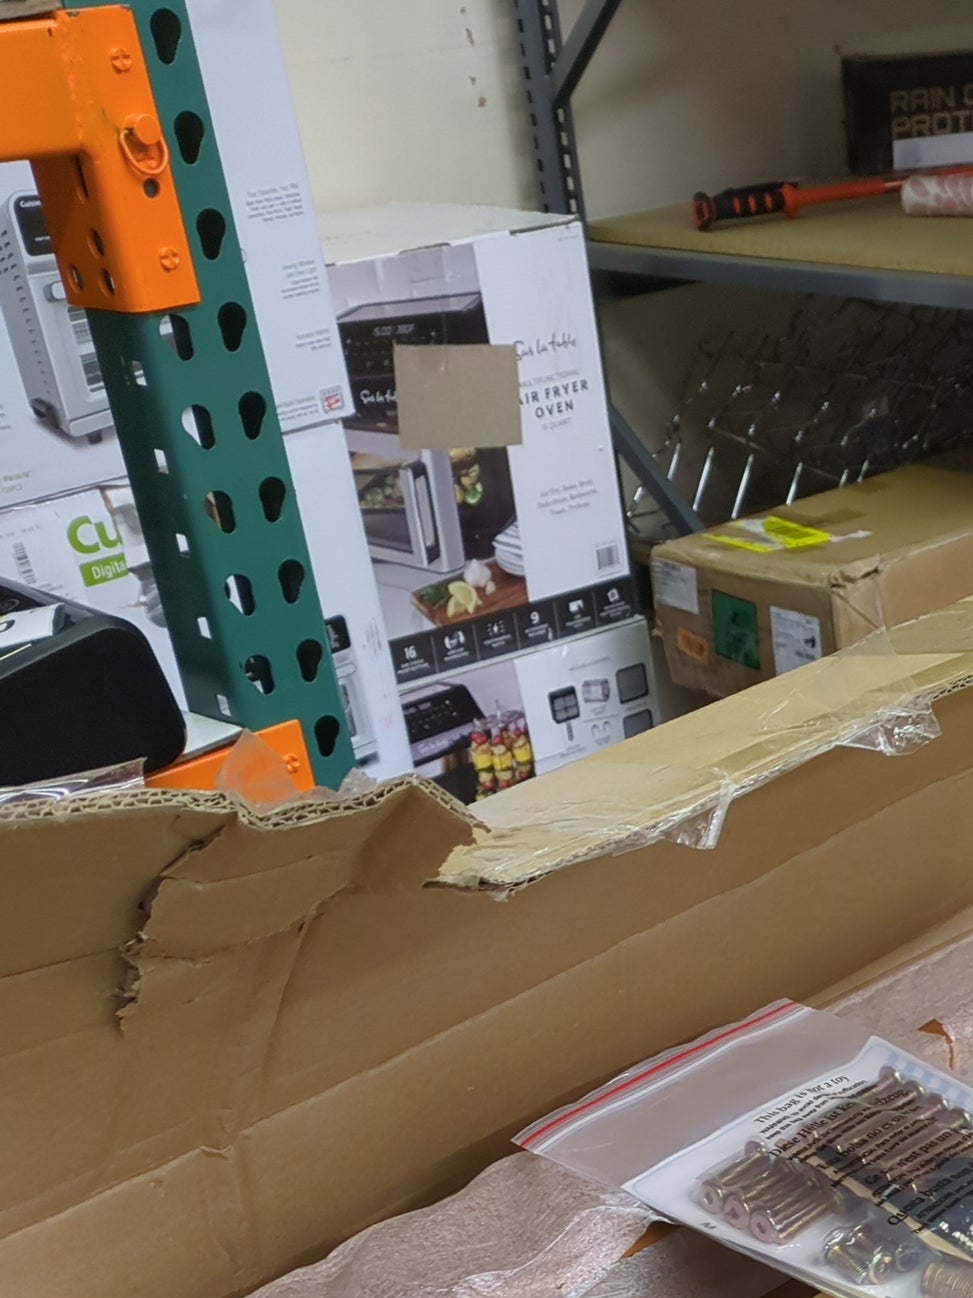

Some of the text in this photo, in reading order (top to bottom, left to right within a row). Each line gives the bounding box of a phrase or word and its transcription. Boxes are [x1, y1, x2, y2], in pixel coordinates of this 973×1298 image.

[890, 85, 955, 113] RAIN
[519, 378, 590, 406] IR FRYER
[535, 401, 574, 419] OVEN
[67, 515, 123, 554] Cu
[91, 560, 127, 580] Digita
[530, 611, 540, 624] 9
[403, 645, 417, 660] 16
[753, 1110, 779, 1124] This
[778, 1098, 801, 1113] bag
[795, 1089, 807, 1099] is
[888, 1197, 925, 1225] Questa
[920, 1178, 952, 1197] busta
